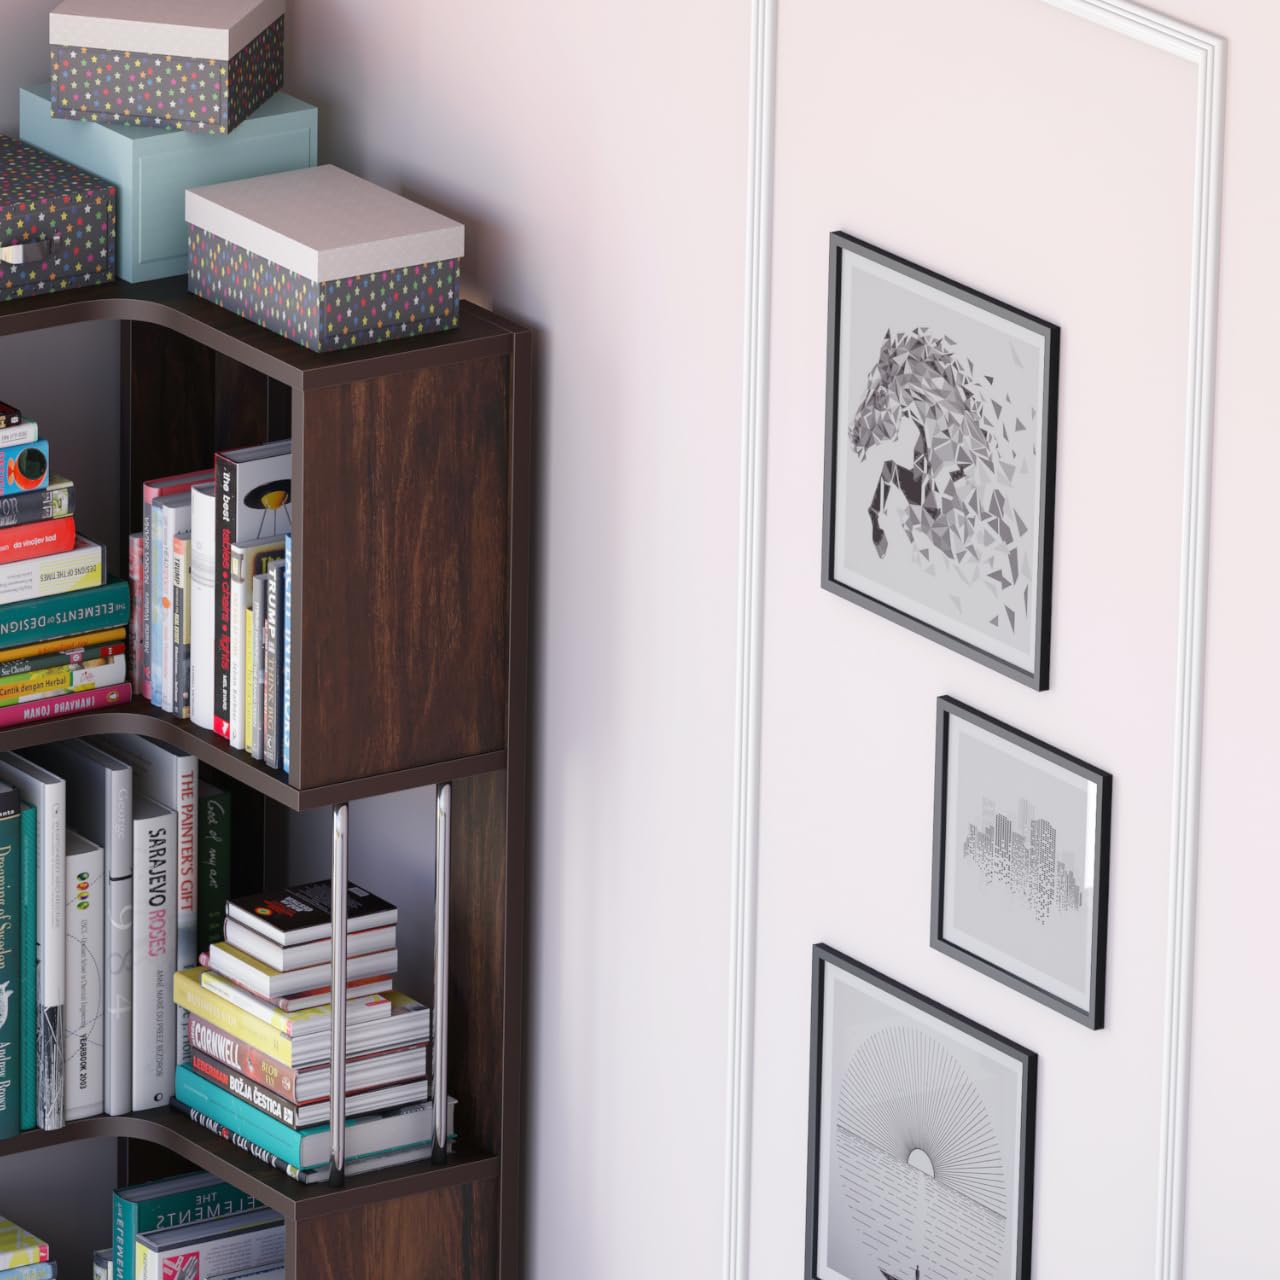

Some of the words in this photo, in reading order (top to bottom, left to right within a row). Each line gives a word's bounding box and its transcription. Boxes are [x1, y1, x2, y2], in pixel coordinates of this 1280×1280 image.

[223, 472, 231, 492] the
[223, 494, 231, 522] best
[39, 573, 56, 583] TIMES
[56, 571, 68, 581] THE
[75, 564, 97, 577] DESIGNS
[56, 602, 115, 624] ELEMENTS
[269, 569, 277, 638] TRUMP
[0, 615, 47, 635] DESIGN
[19, 682, 44, 697] dengan
[44, 676, 66, 690] Herbal
[22, 705, 51, 721] MANOJ
[53, 696, 96, 714] BHAVNANI
[181, 770, 193, 800] THE
[181, 803, 194, 876] PAINTER'S
[148, 828, 167, 907] SARAJEVO
[181, 879, 193, 911] GIFT
[147, 908, 166, 958] ROSES
[79, 1033, 88, 1071] YEARBOOK
[195, 1023, 241, 1071] CORNWELL
[229, 1075, 253, 1100] BOŽJA
[253, 1086, 282, 1118] ČESTICA
